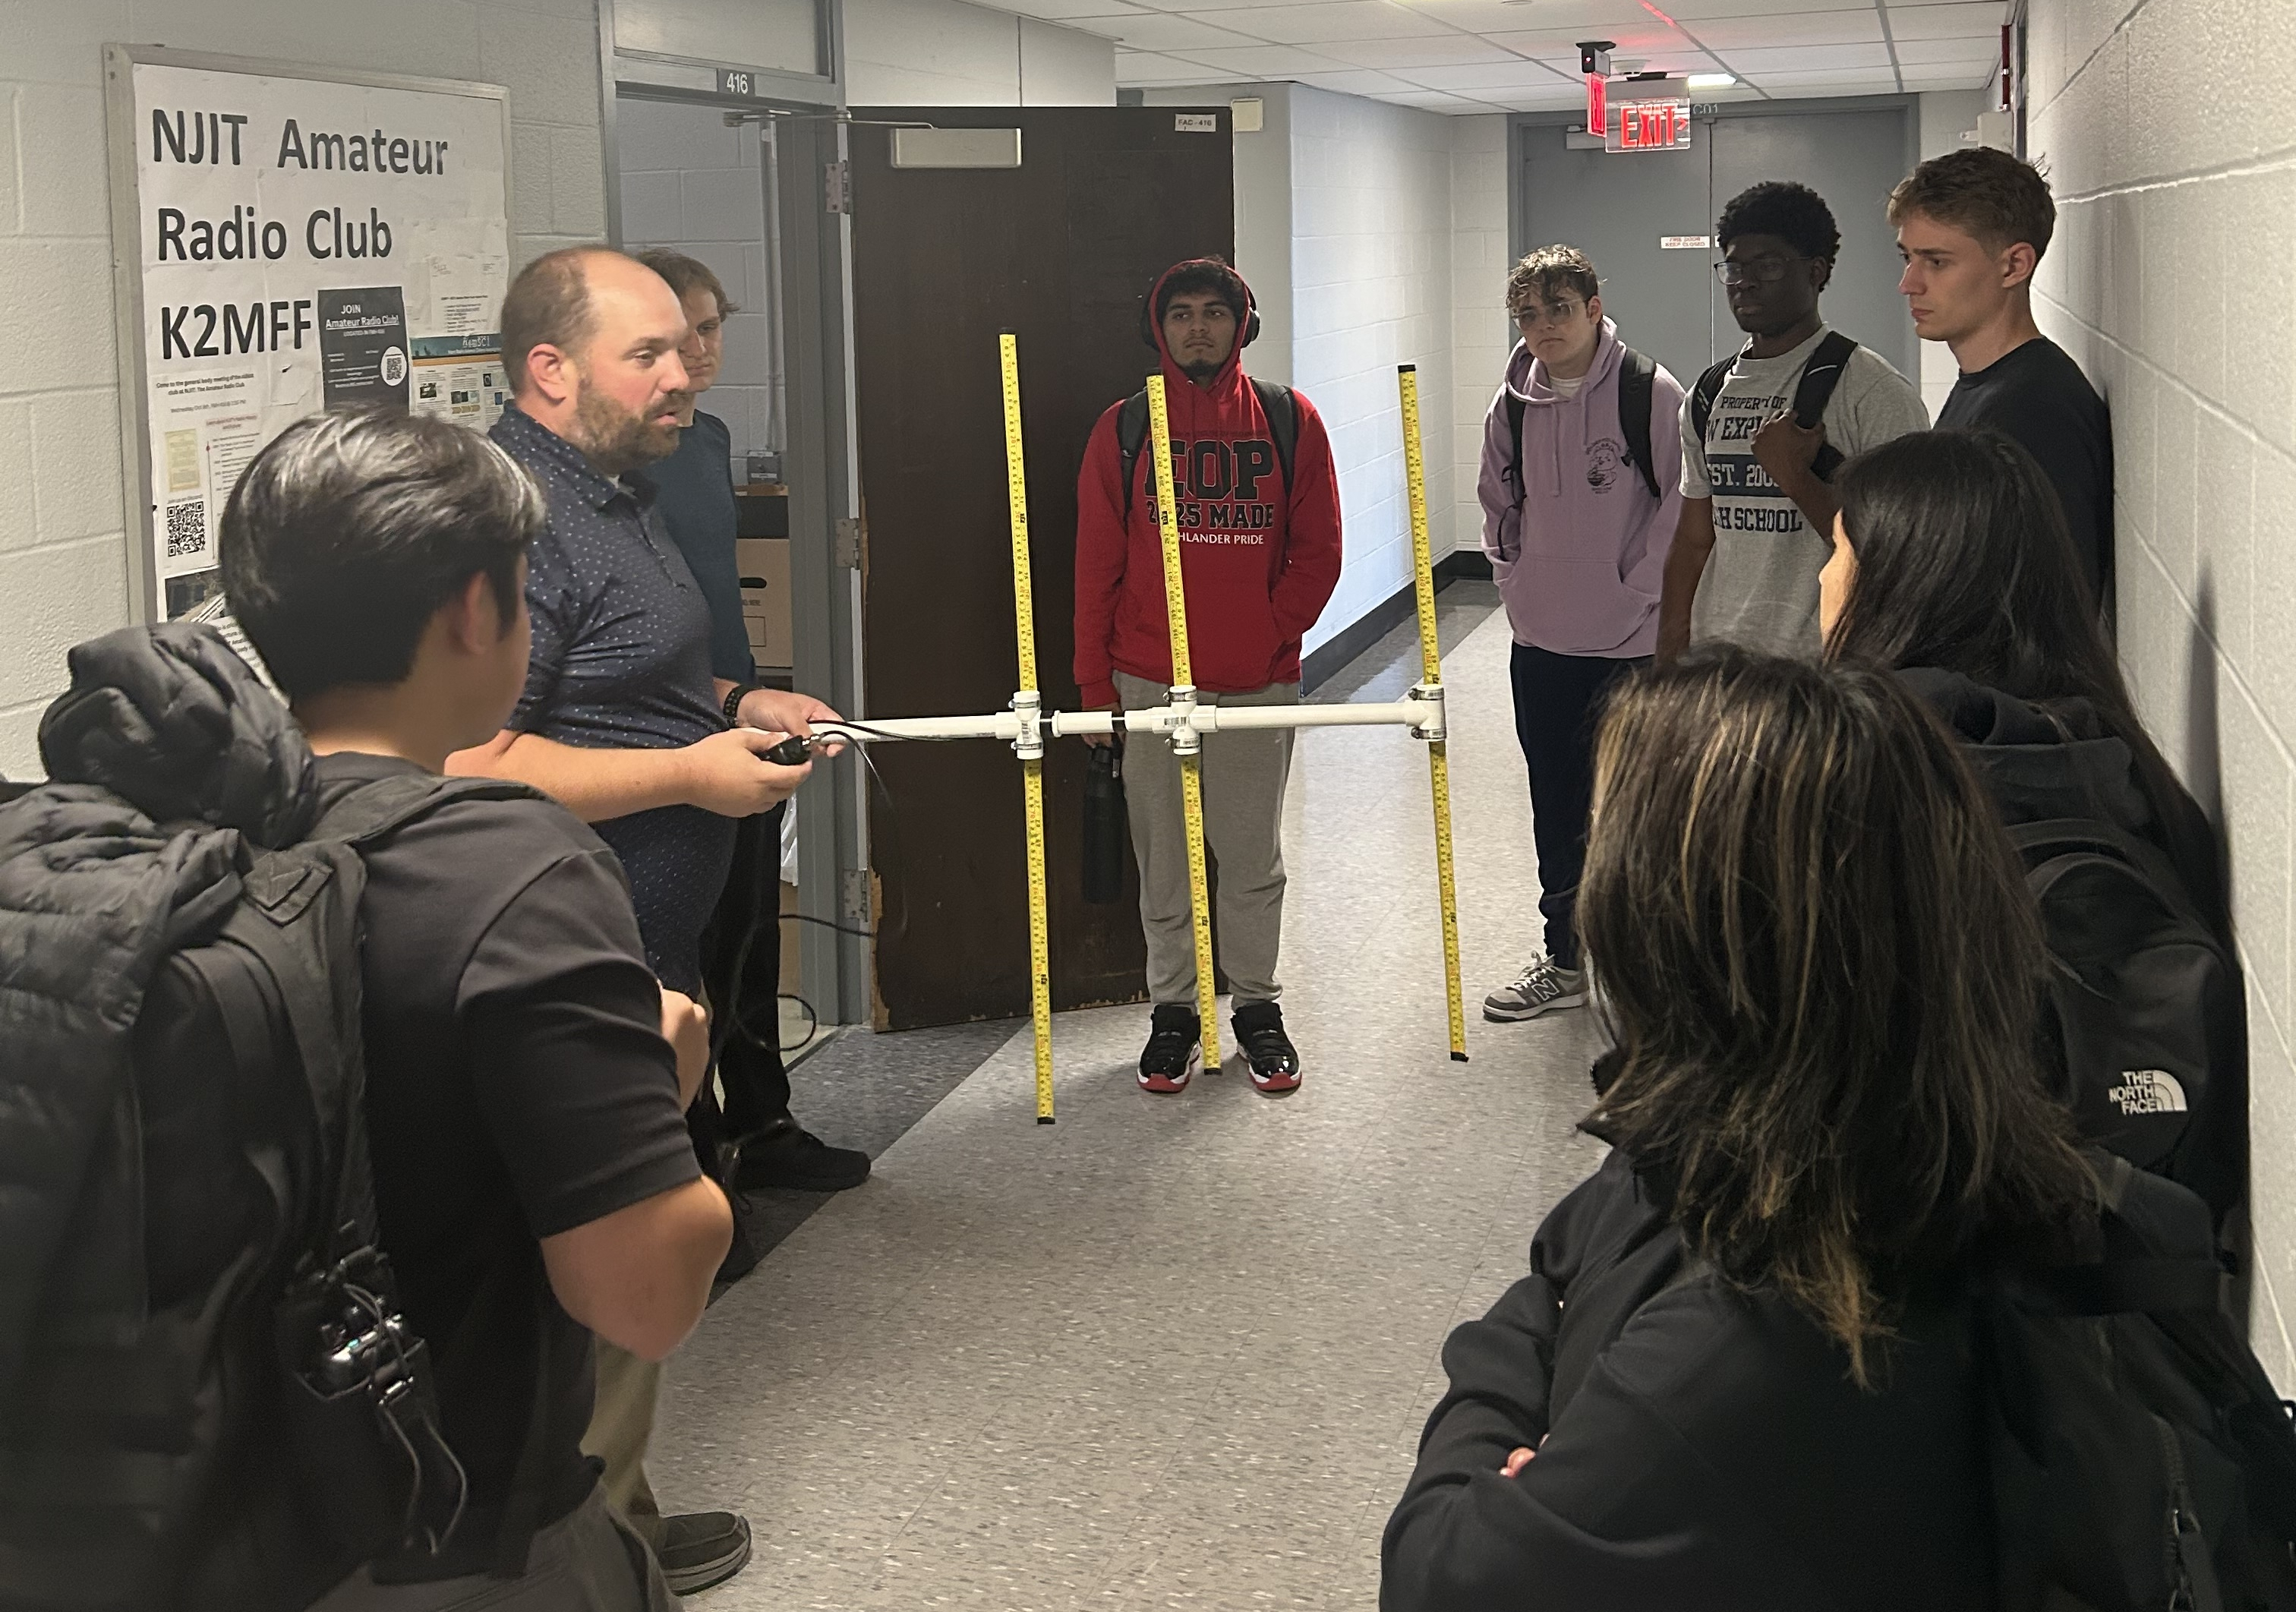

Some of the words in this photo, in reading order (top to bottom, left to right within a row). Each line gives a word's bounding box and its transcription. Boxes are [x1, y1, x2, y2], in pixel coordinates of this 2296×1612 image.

[727, 73, 748, 94] 416
[1620, 104, 1678, 148] EXIT
[153, 109, 248, 166] NJIT
[277, 119, 448, 175] Amateur
[158, 205, 287, 261] Radio
[306, 207, 392, 258] Club
[341, 304, 361, 314] JOIN
[162, 300, 311, 359] K2MFF
[326, 319, 360, 328] Amateur
[361, 316, 381, 325] Radio
[1720, 396, 1772, 410] PROPERY
[1771, 396, 1787, 409] OF
[1144, 438, 1274, 501] EOP
[1707, 463, 1739, 486] ST.
[1146, 500, 1202, 528] 225
[1208, 503, 1276, 530] MADE
[1735, 507, 1802, 532] SCHOOL
[1159, 530, 1230, 544] HLANDER
[1234, 534, 1264, 544] PRIDE
[2122, 1071, 2153, 1085] THE
[2108, 1084, 2155, 1103] NORTH
[2121, 1099, 2157, 1115] FACE
